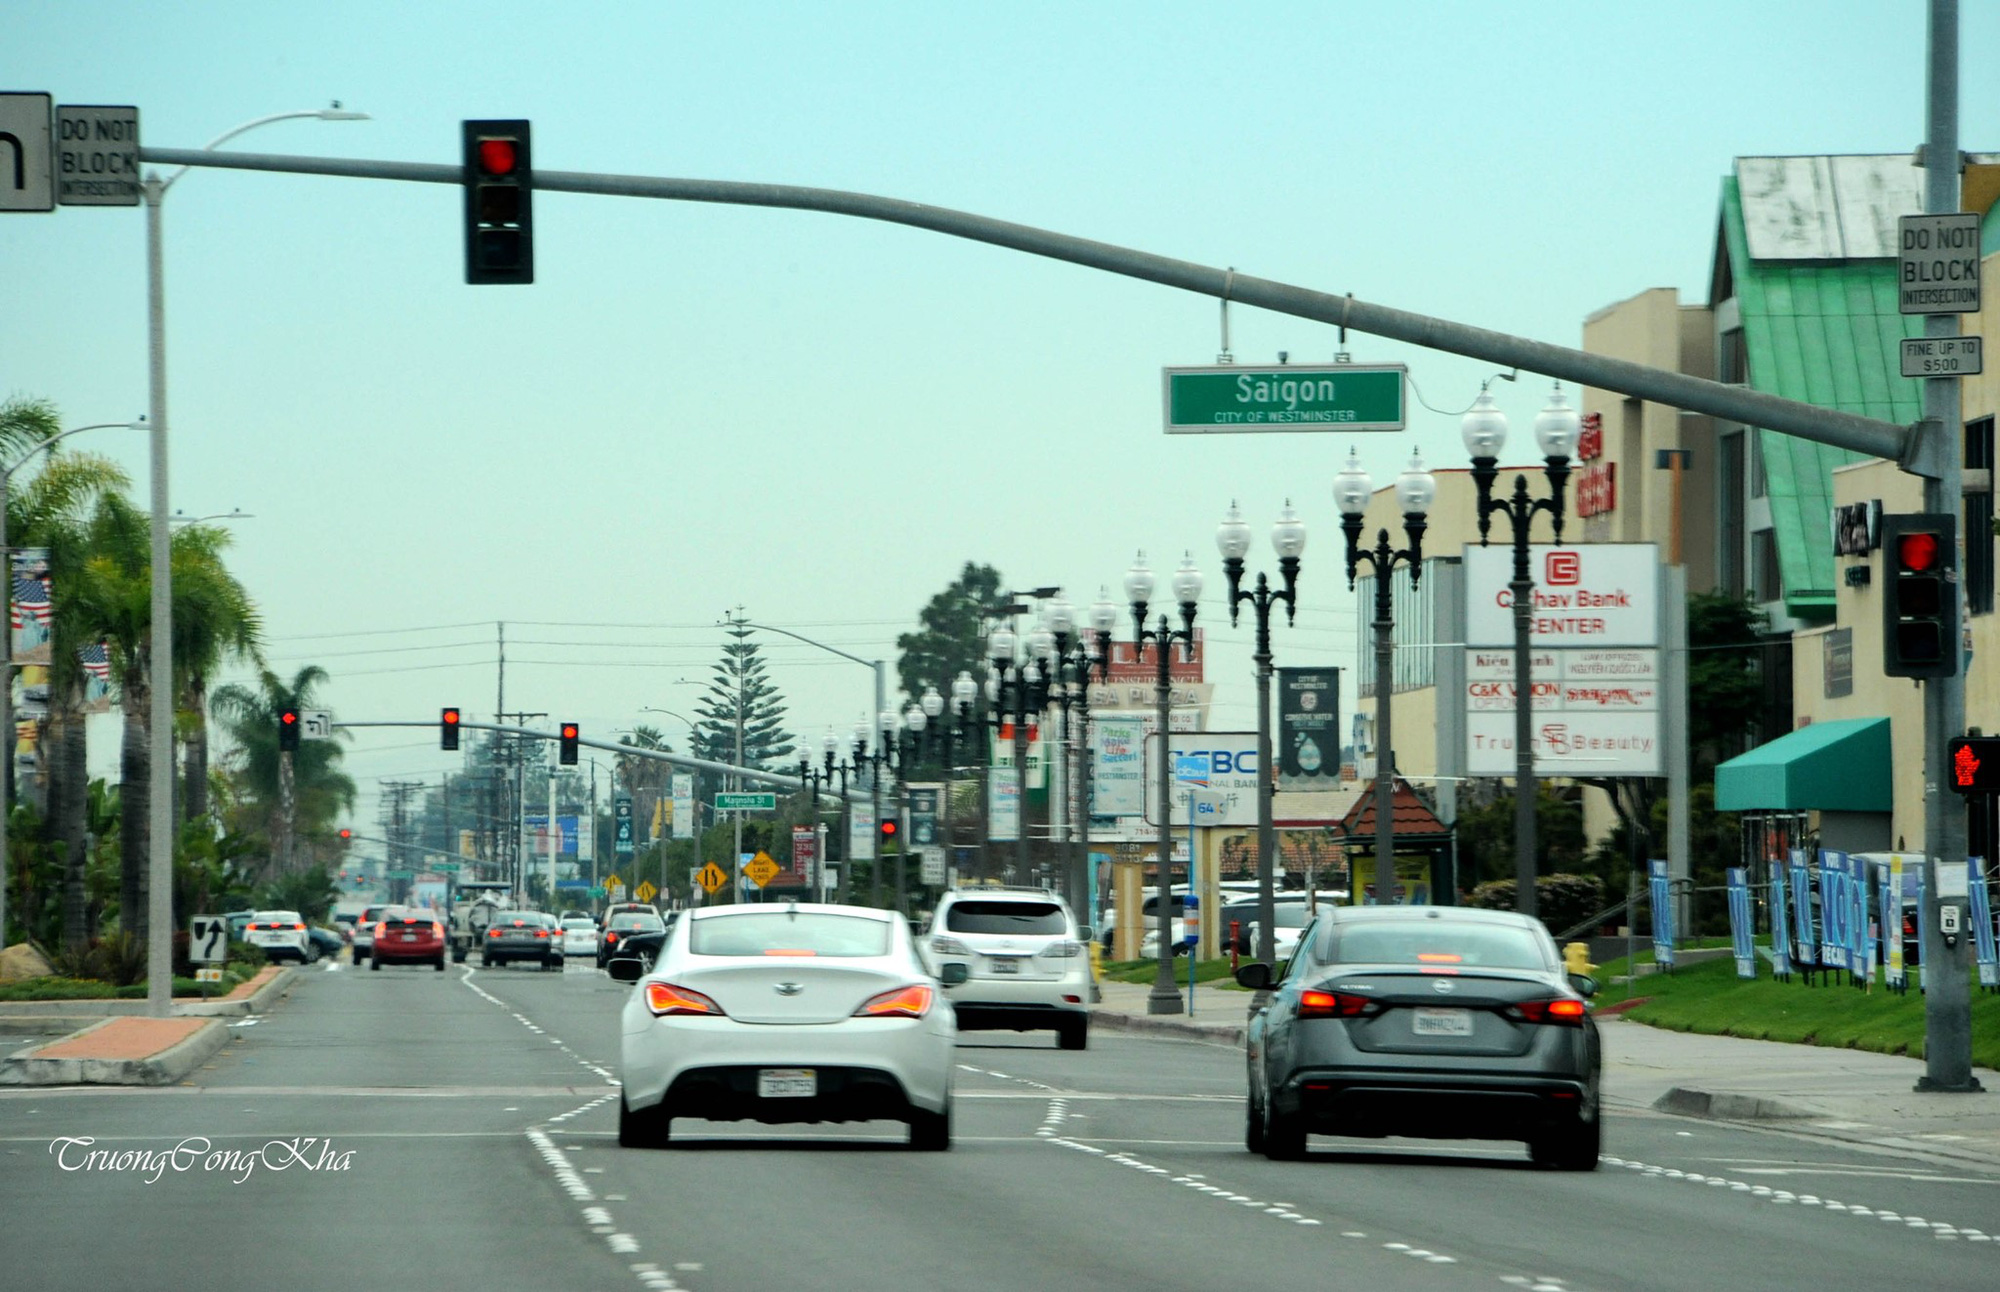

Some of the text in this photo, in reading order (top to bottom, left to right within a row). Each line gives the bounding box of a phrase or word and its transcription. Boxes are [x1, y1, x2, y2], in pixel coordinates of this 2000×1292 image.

[62, 119, 136, 142] DO NOT
[62, 151, 137, 174] BLOCK
[62, 180, 137, 196] INTERSECTION
[1903, 227, 1977, 251] DO NOT
[1903, 259, 1976, 283] BLOCK
[1902, 287, 1977, 305] INTERSECTION
[1906, 341, 1975, 356] FINE UP TO
[1924, 358, 1959, 372] $500
[1236, 374, 1335, 411] Saigon
[1214, 409, 1357, 424] CITY OF WESTMINSTER
[1577, 589, 1631, 608] Bank
[1129, 687, 1199, 705] PLZA
[1469, 683, 1502, 697] C&K
[1100, 726, 1132, 738] Parks
[1572, 735, 1653, 753] Beauty
[1234, 779, 1259, 789] BAN
[724, 796, 765, 805] Magnolia St
